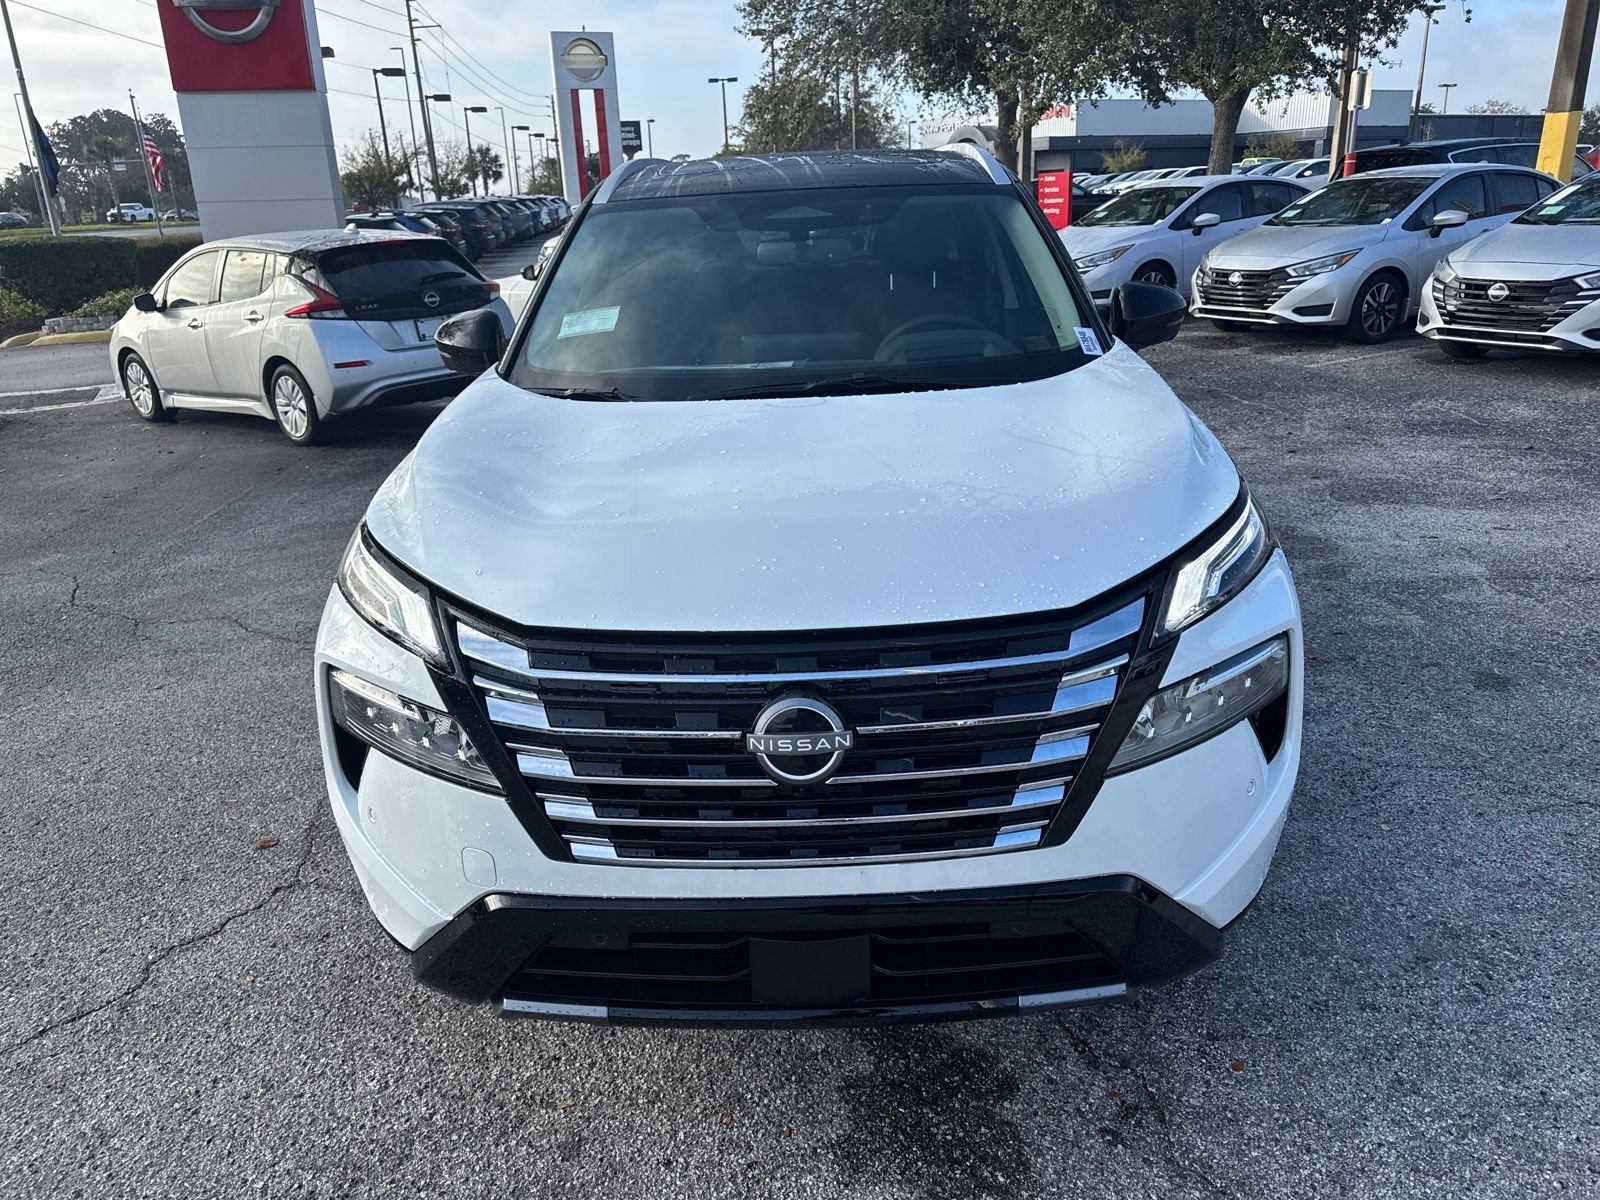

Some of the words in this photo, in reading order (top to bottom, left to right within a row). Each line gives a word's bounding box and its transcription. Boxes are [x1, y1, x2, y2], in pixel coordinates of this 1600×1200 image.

[925, 125, 939, 135] New
[355, 303, 379, 311] LEAF
[749, 734, 850, 752] NISSAN
